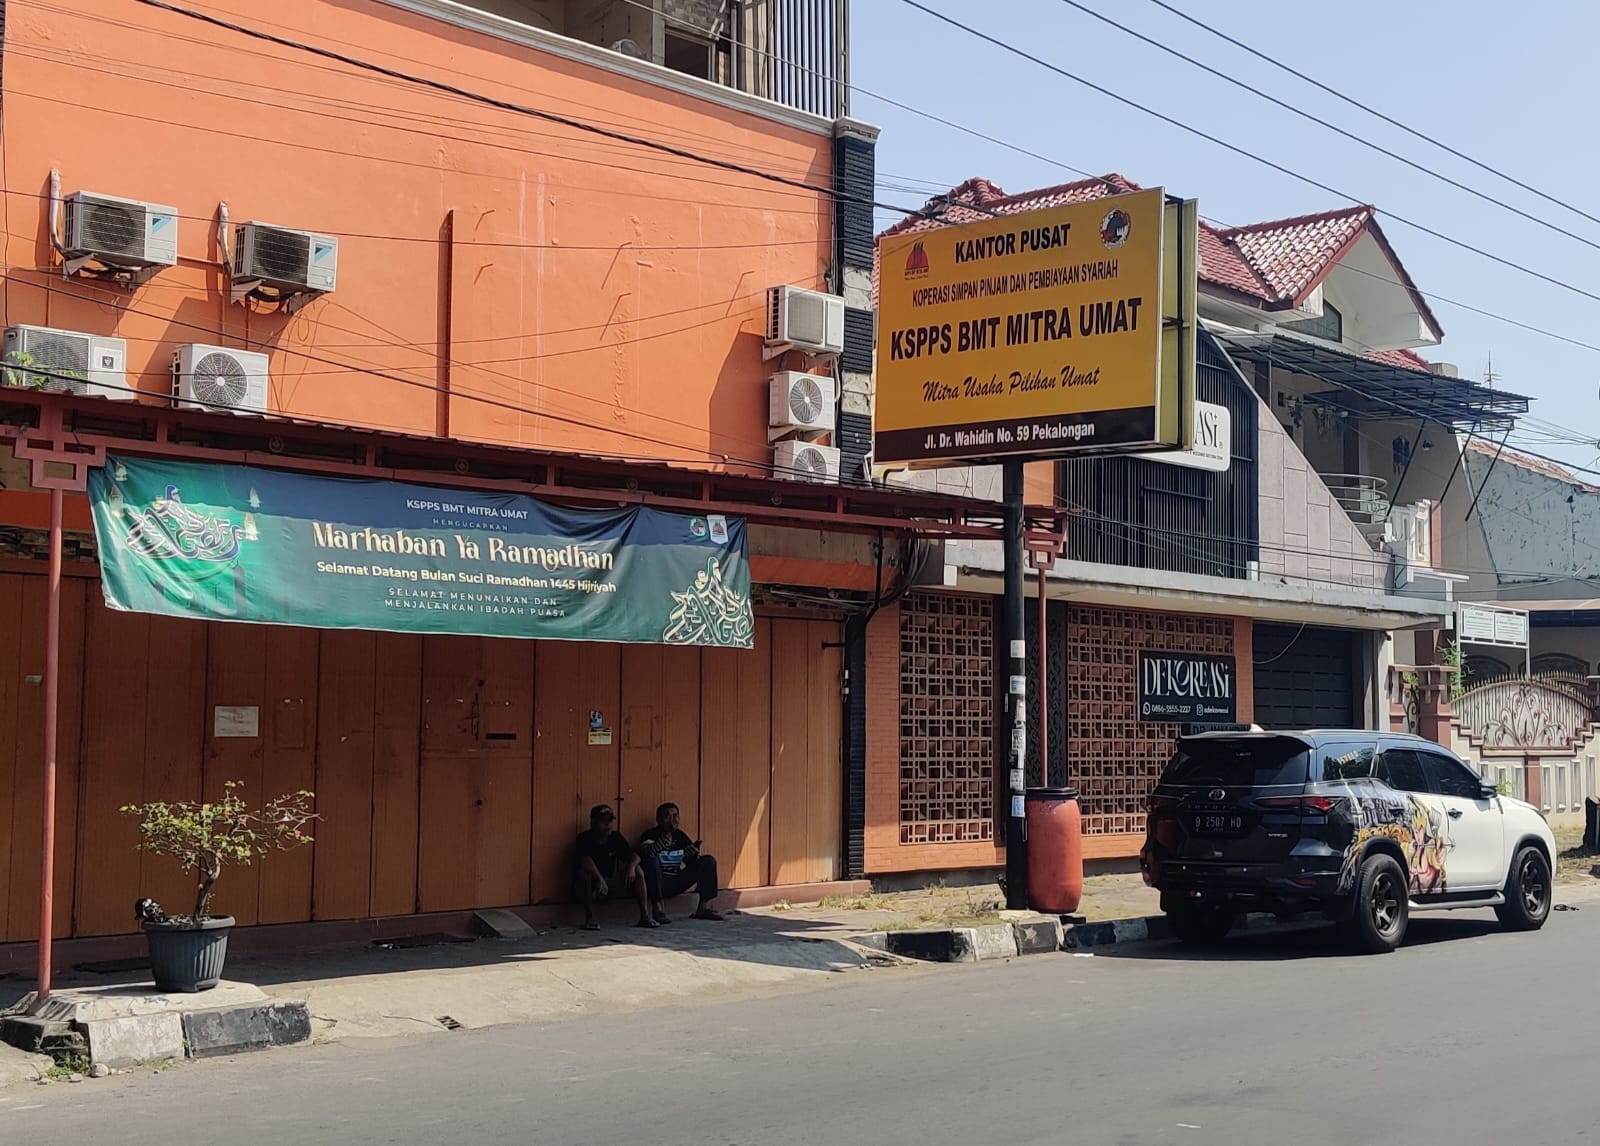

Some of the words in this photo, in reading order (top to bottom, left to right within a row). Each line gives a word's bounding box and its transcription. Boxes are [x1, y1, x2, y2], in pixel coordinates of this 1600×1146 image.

[955, 233, 1016, 264] KANTOR
[1020, 223, 1071, 253] PUSAT
[912, 284, 950, 308] KOPERASI
[951, 279, 978, 303] SIMPAN
[980, 274, 1008, 299] PINJAM
[1010, 272, 1027, 293] DAN
[1028, 264, 1080, 291] PEMBIAYAAN
[1081, 258, 1119, 282] SYARIAH
[890, 322, 952, 361] KSPPS
[957, 316, 1001, 352] BMT
[1006, 307, 1072, 346] MITRA
[1079, 297, 1142, 336] UMAT
[922, 381, 960, 402] Mitra
[963, 374, 1004, 398] Usaha
[1008, 368, 1056, 396] Pilihan
[1060, 365, 1100, 388] Umat
[924, 435, 937, 450] Jl.
[939, 432, 953, 448] Dr.
[954, 429, 995, 447] Wahidin
[997, 427, 1014, 444] No.
[1016, 425, 1030, 442] 59
[1032, 422, 1095, 441] Pekalongan
[406, 499, 441, 512] KSPPS
[442, 503, 465, 515] BMT
[466, 506, 499, 517] MITRA
[500, 509, 529, 520] UMAT
[433, 518, 509, 531] MENGUCAPKAN
[312, 521, 447, 558] Marhaban
[453, 533, 481, 560] Ya
[488, 537, 614, 572] Ramadhan
[316, 561, 370, 576] Selamat
[372, 566, 418, 582] Datang
[421, 569, 456, 583] Bulan
[458, 571, 484, 584] Suci
[486, 574, 548, 589] Ramadhan
[549, 578, 576, 590] 1445
[577, 580, 617, 595] Hijriyah
[384, 599, 474, 613] MENJALANKAN
[480, 605, 525, 616] IBADAH
[530, 608, 565, 618] PUASA
[388, 587, 444, 599] SELAMAT
[450, 592, 528, 605] MENUNAIKAN
[534, 597, 557, 606] DAN
[1205, 815, 1225, 828] 2507
